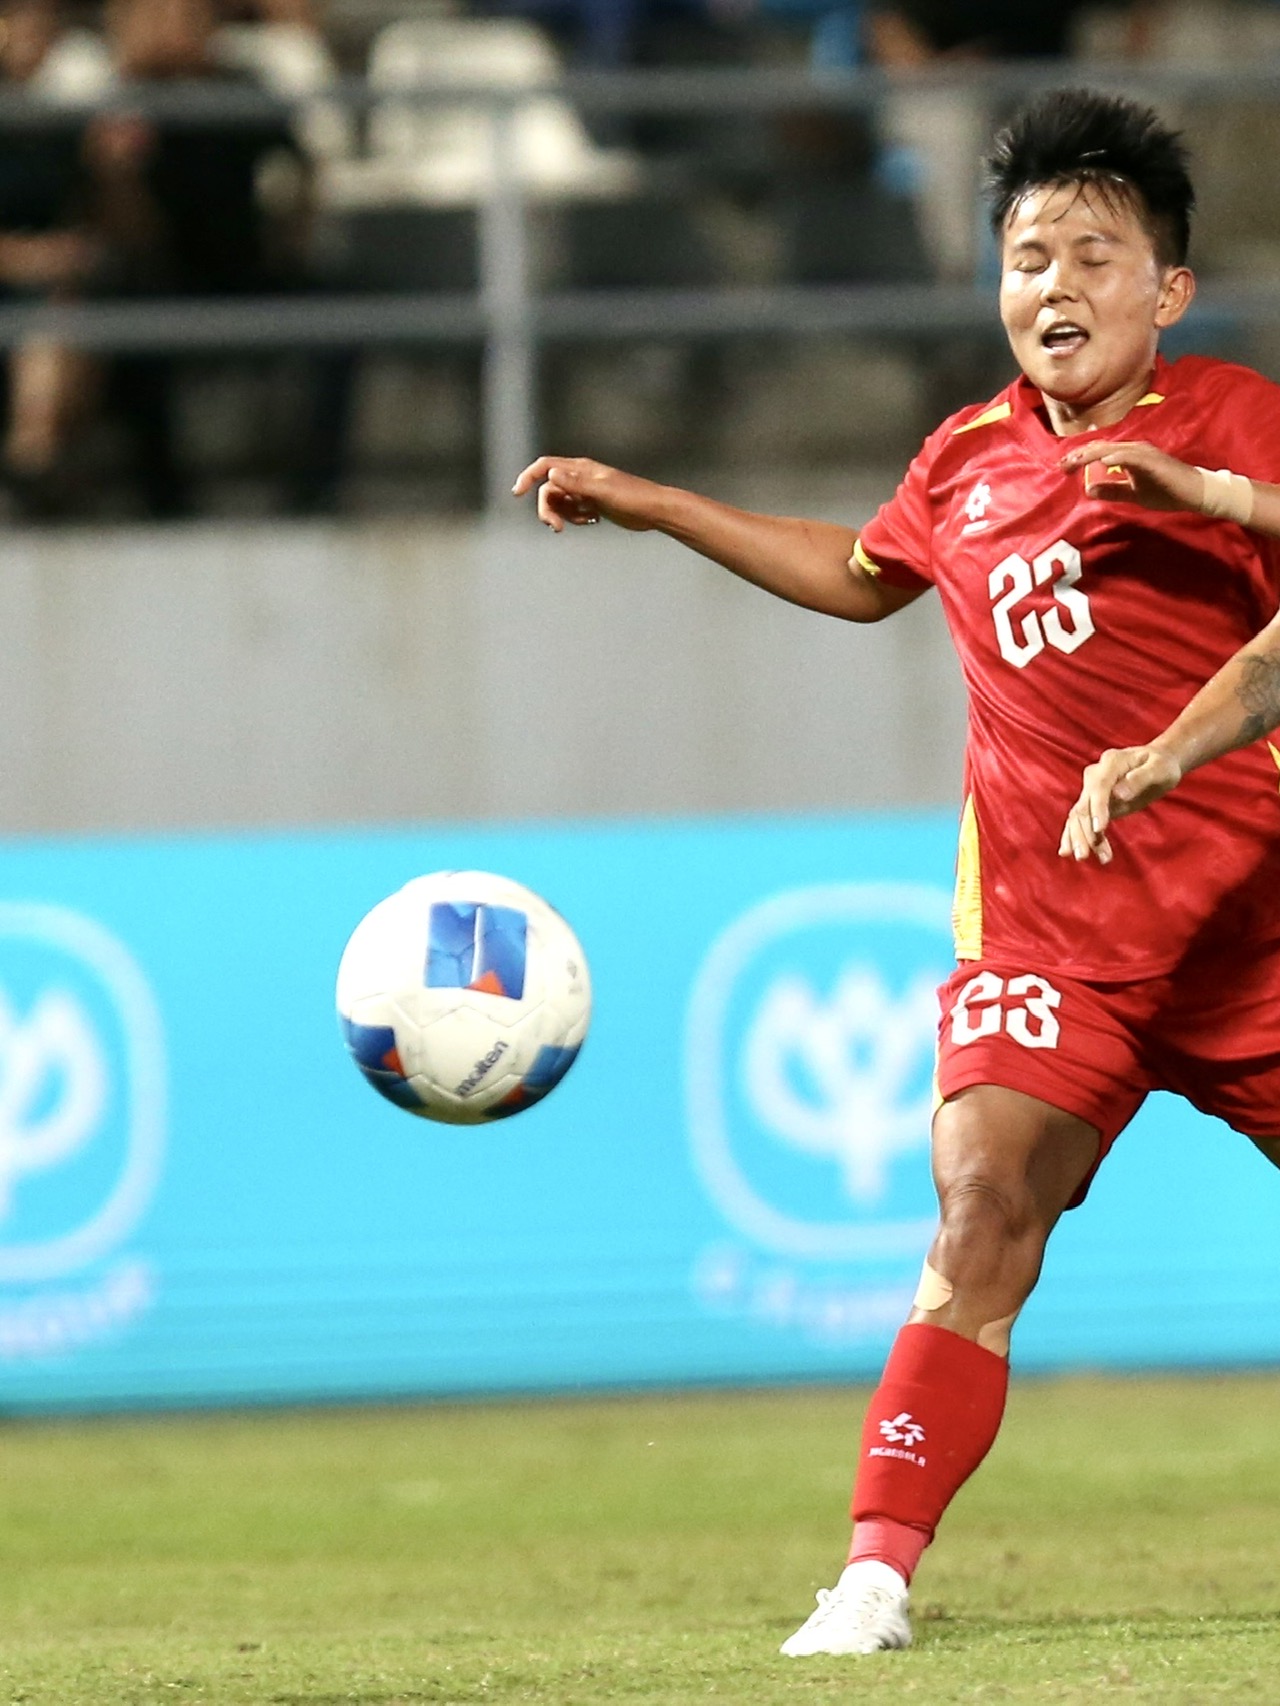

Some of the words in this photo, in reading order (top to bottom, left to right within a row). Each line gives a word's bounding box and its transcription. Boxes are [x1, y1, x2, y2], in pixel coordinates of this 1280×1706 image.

[989, 540, 1096, 668] 23
[951, 971, 1061, 1049] 23
[454, 1040, 508, 1097] molten
